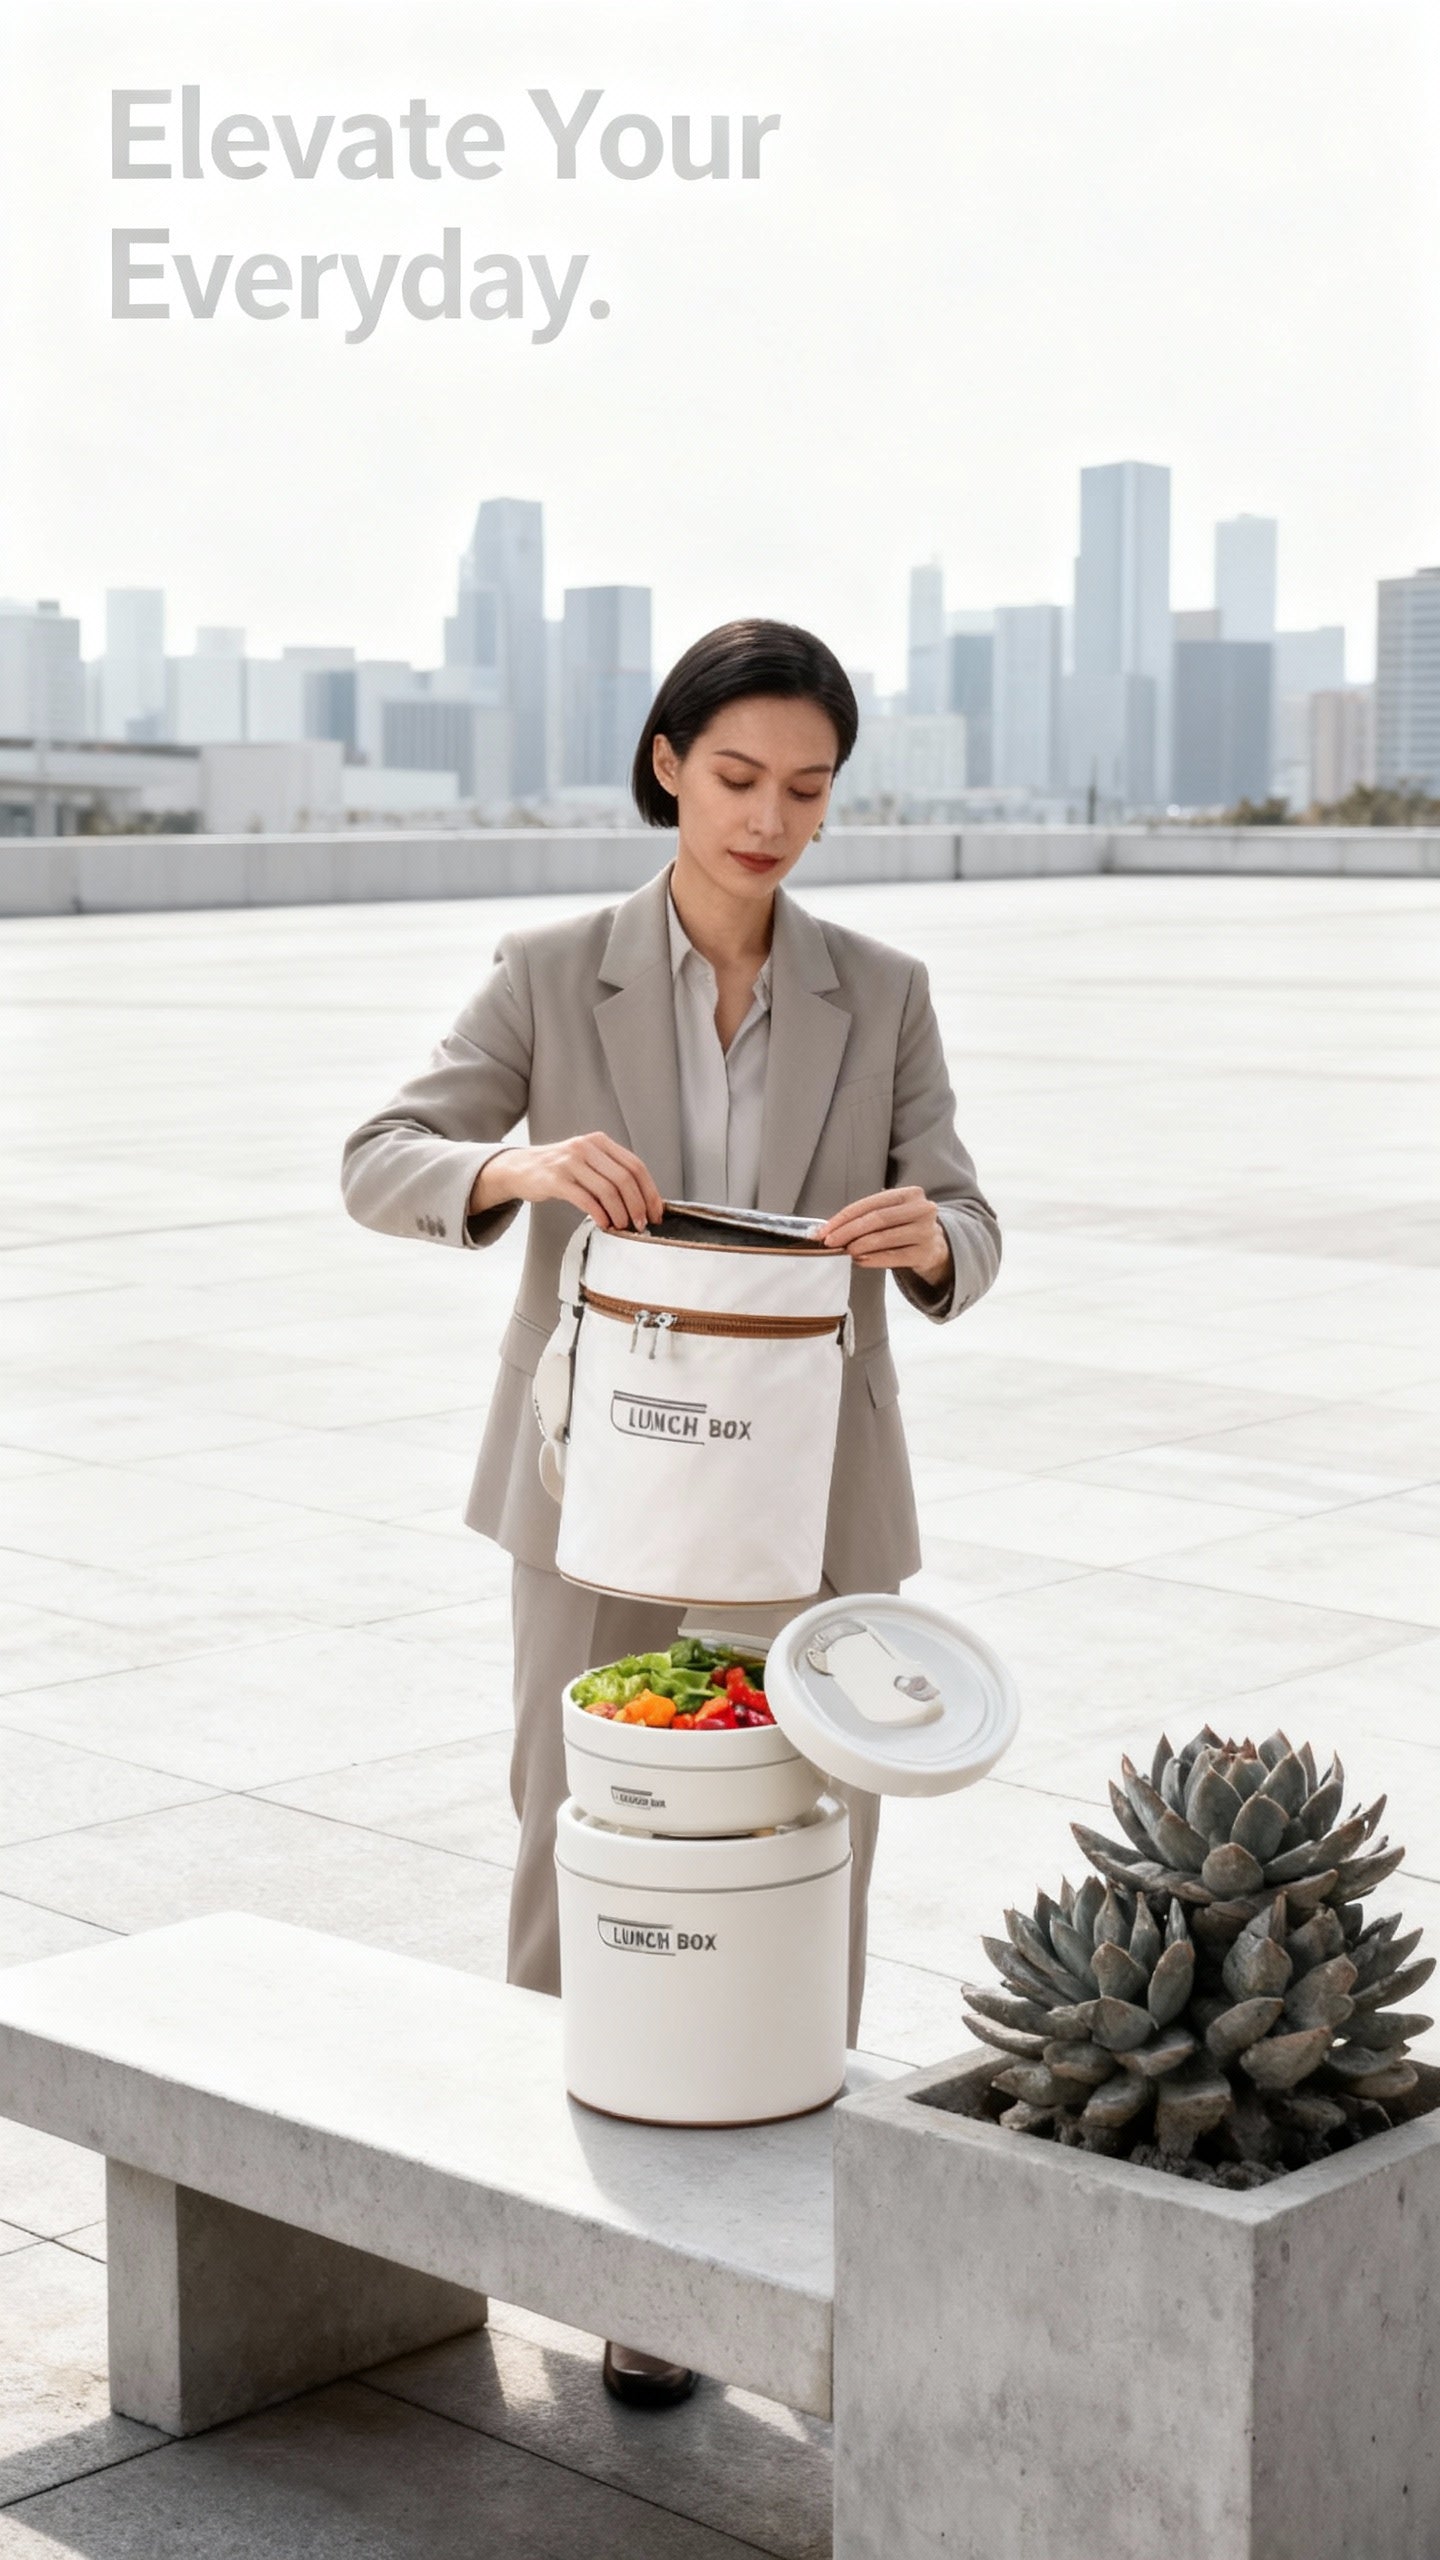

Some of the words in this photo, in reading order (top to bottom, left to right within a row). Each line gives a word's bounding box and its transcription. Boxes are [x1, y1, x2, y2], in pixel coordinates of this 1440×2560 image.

[628, 1407, 698, 1437] LUNCH
[708, 1419, 752, 1440] BOX
[613, 1927, 670, 1950] LUNCH
[677, 1933, 718, 1951] BOX
